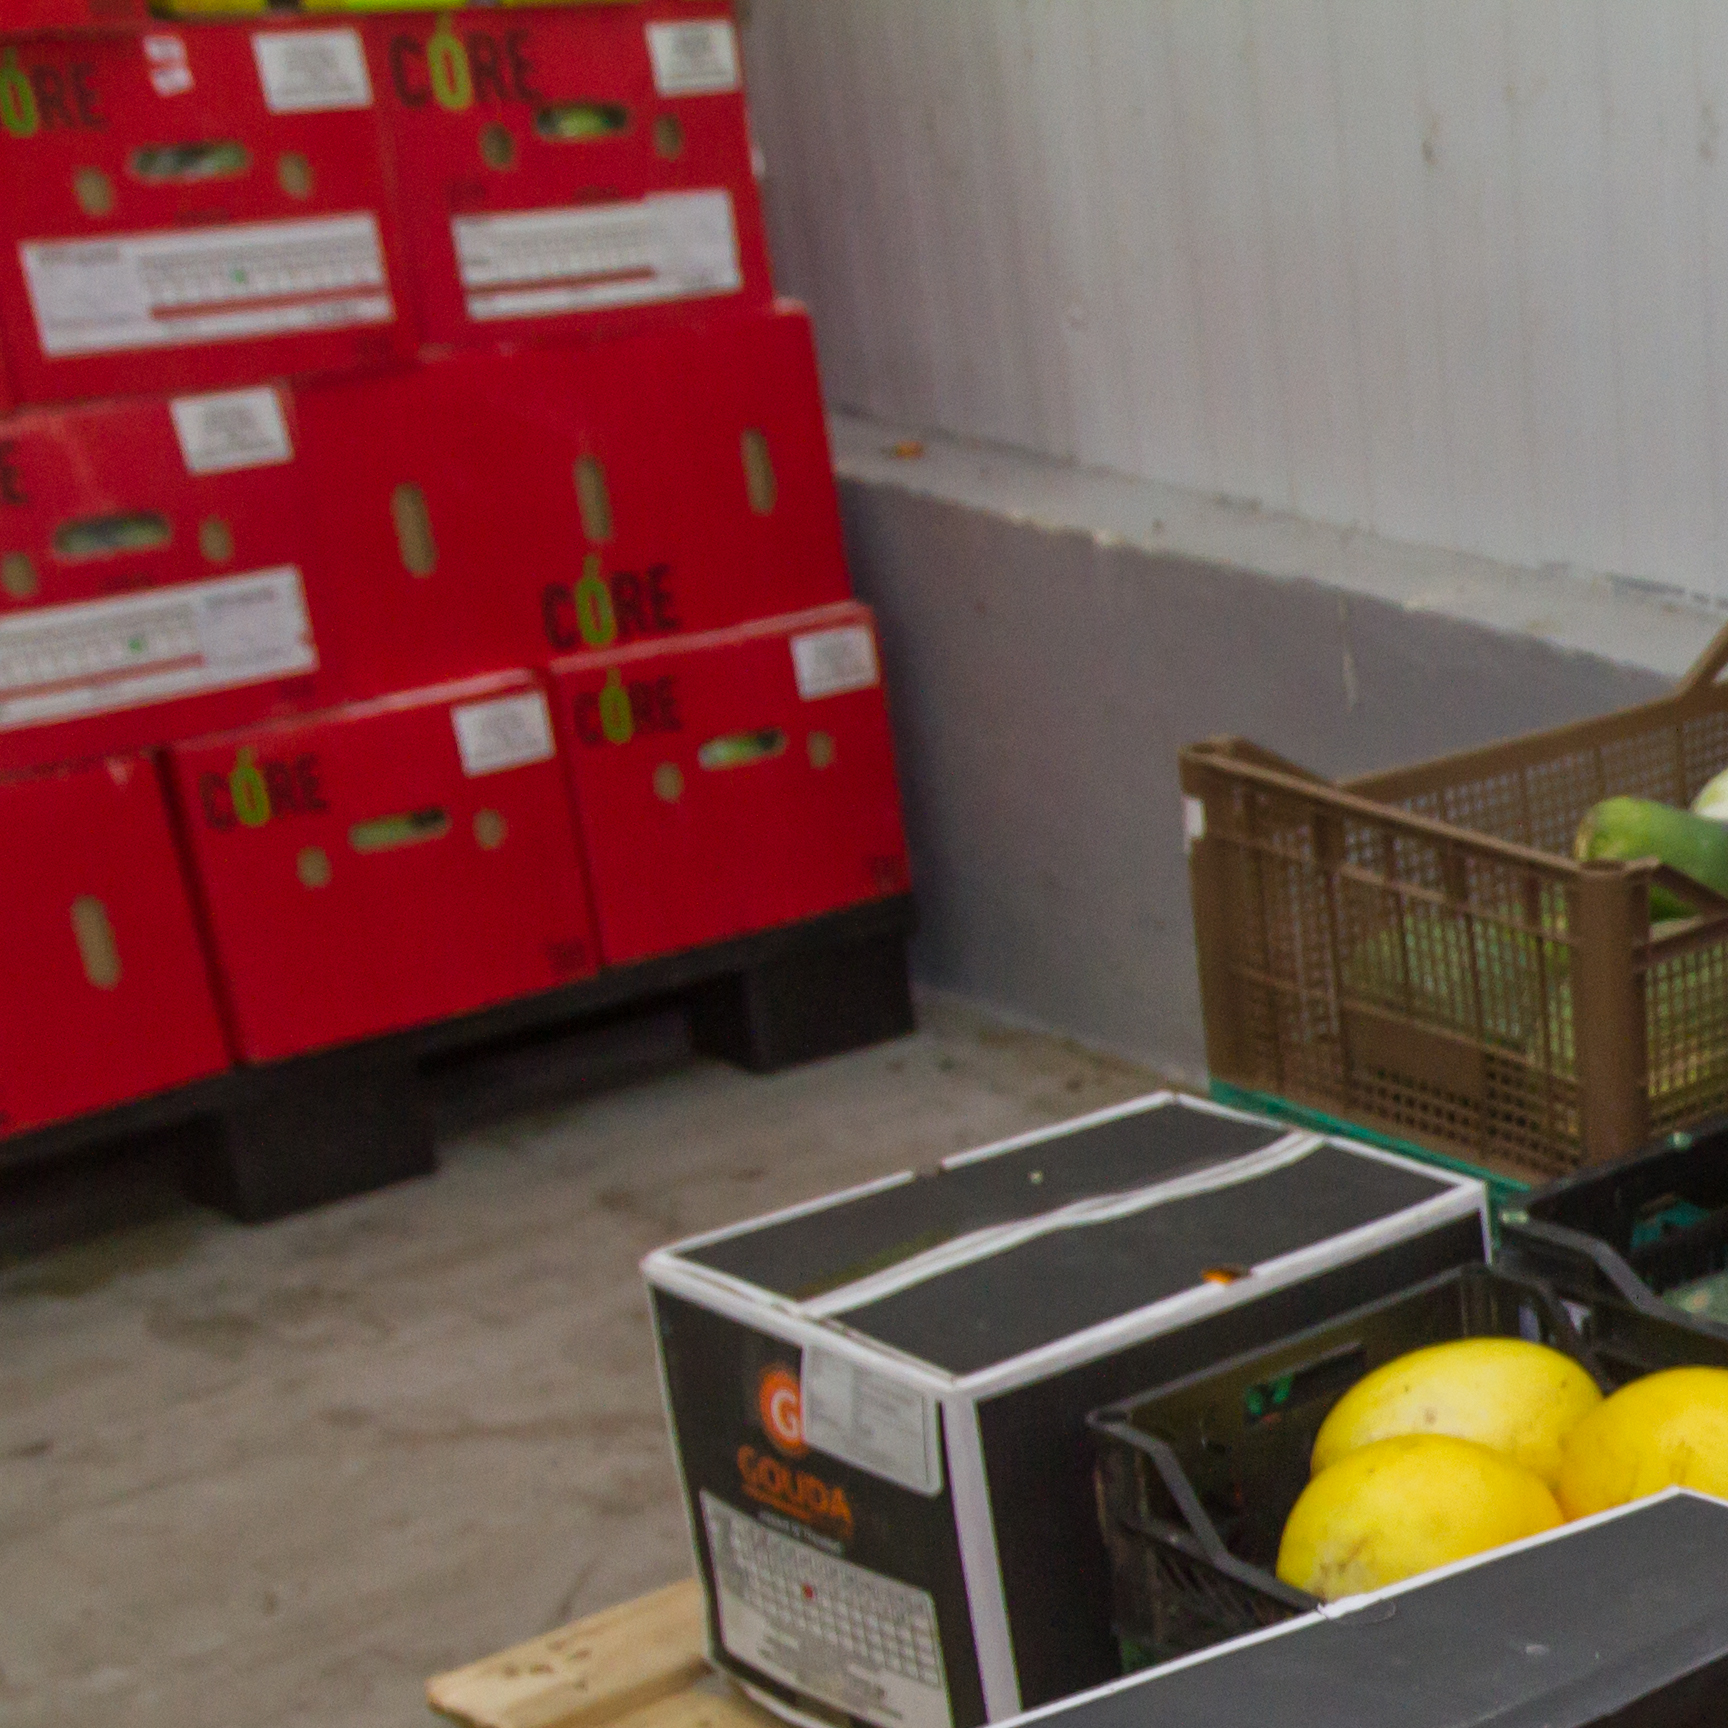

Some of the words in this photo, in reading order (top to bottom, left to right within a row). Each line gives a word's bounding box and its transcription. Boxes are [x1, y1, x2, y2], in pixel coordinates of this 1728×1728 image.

[0, 48, 110, 138] ORE
[388, 14, 542, 111] CORE
[541, 554, 680, 650] CORE
[573, 666, 682, 744] CORE
[200, 746, 328, 832] CORE
